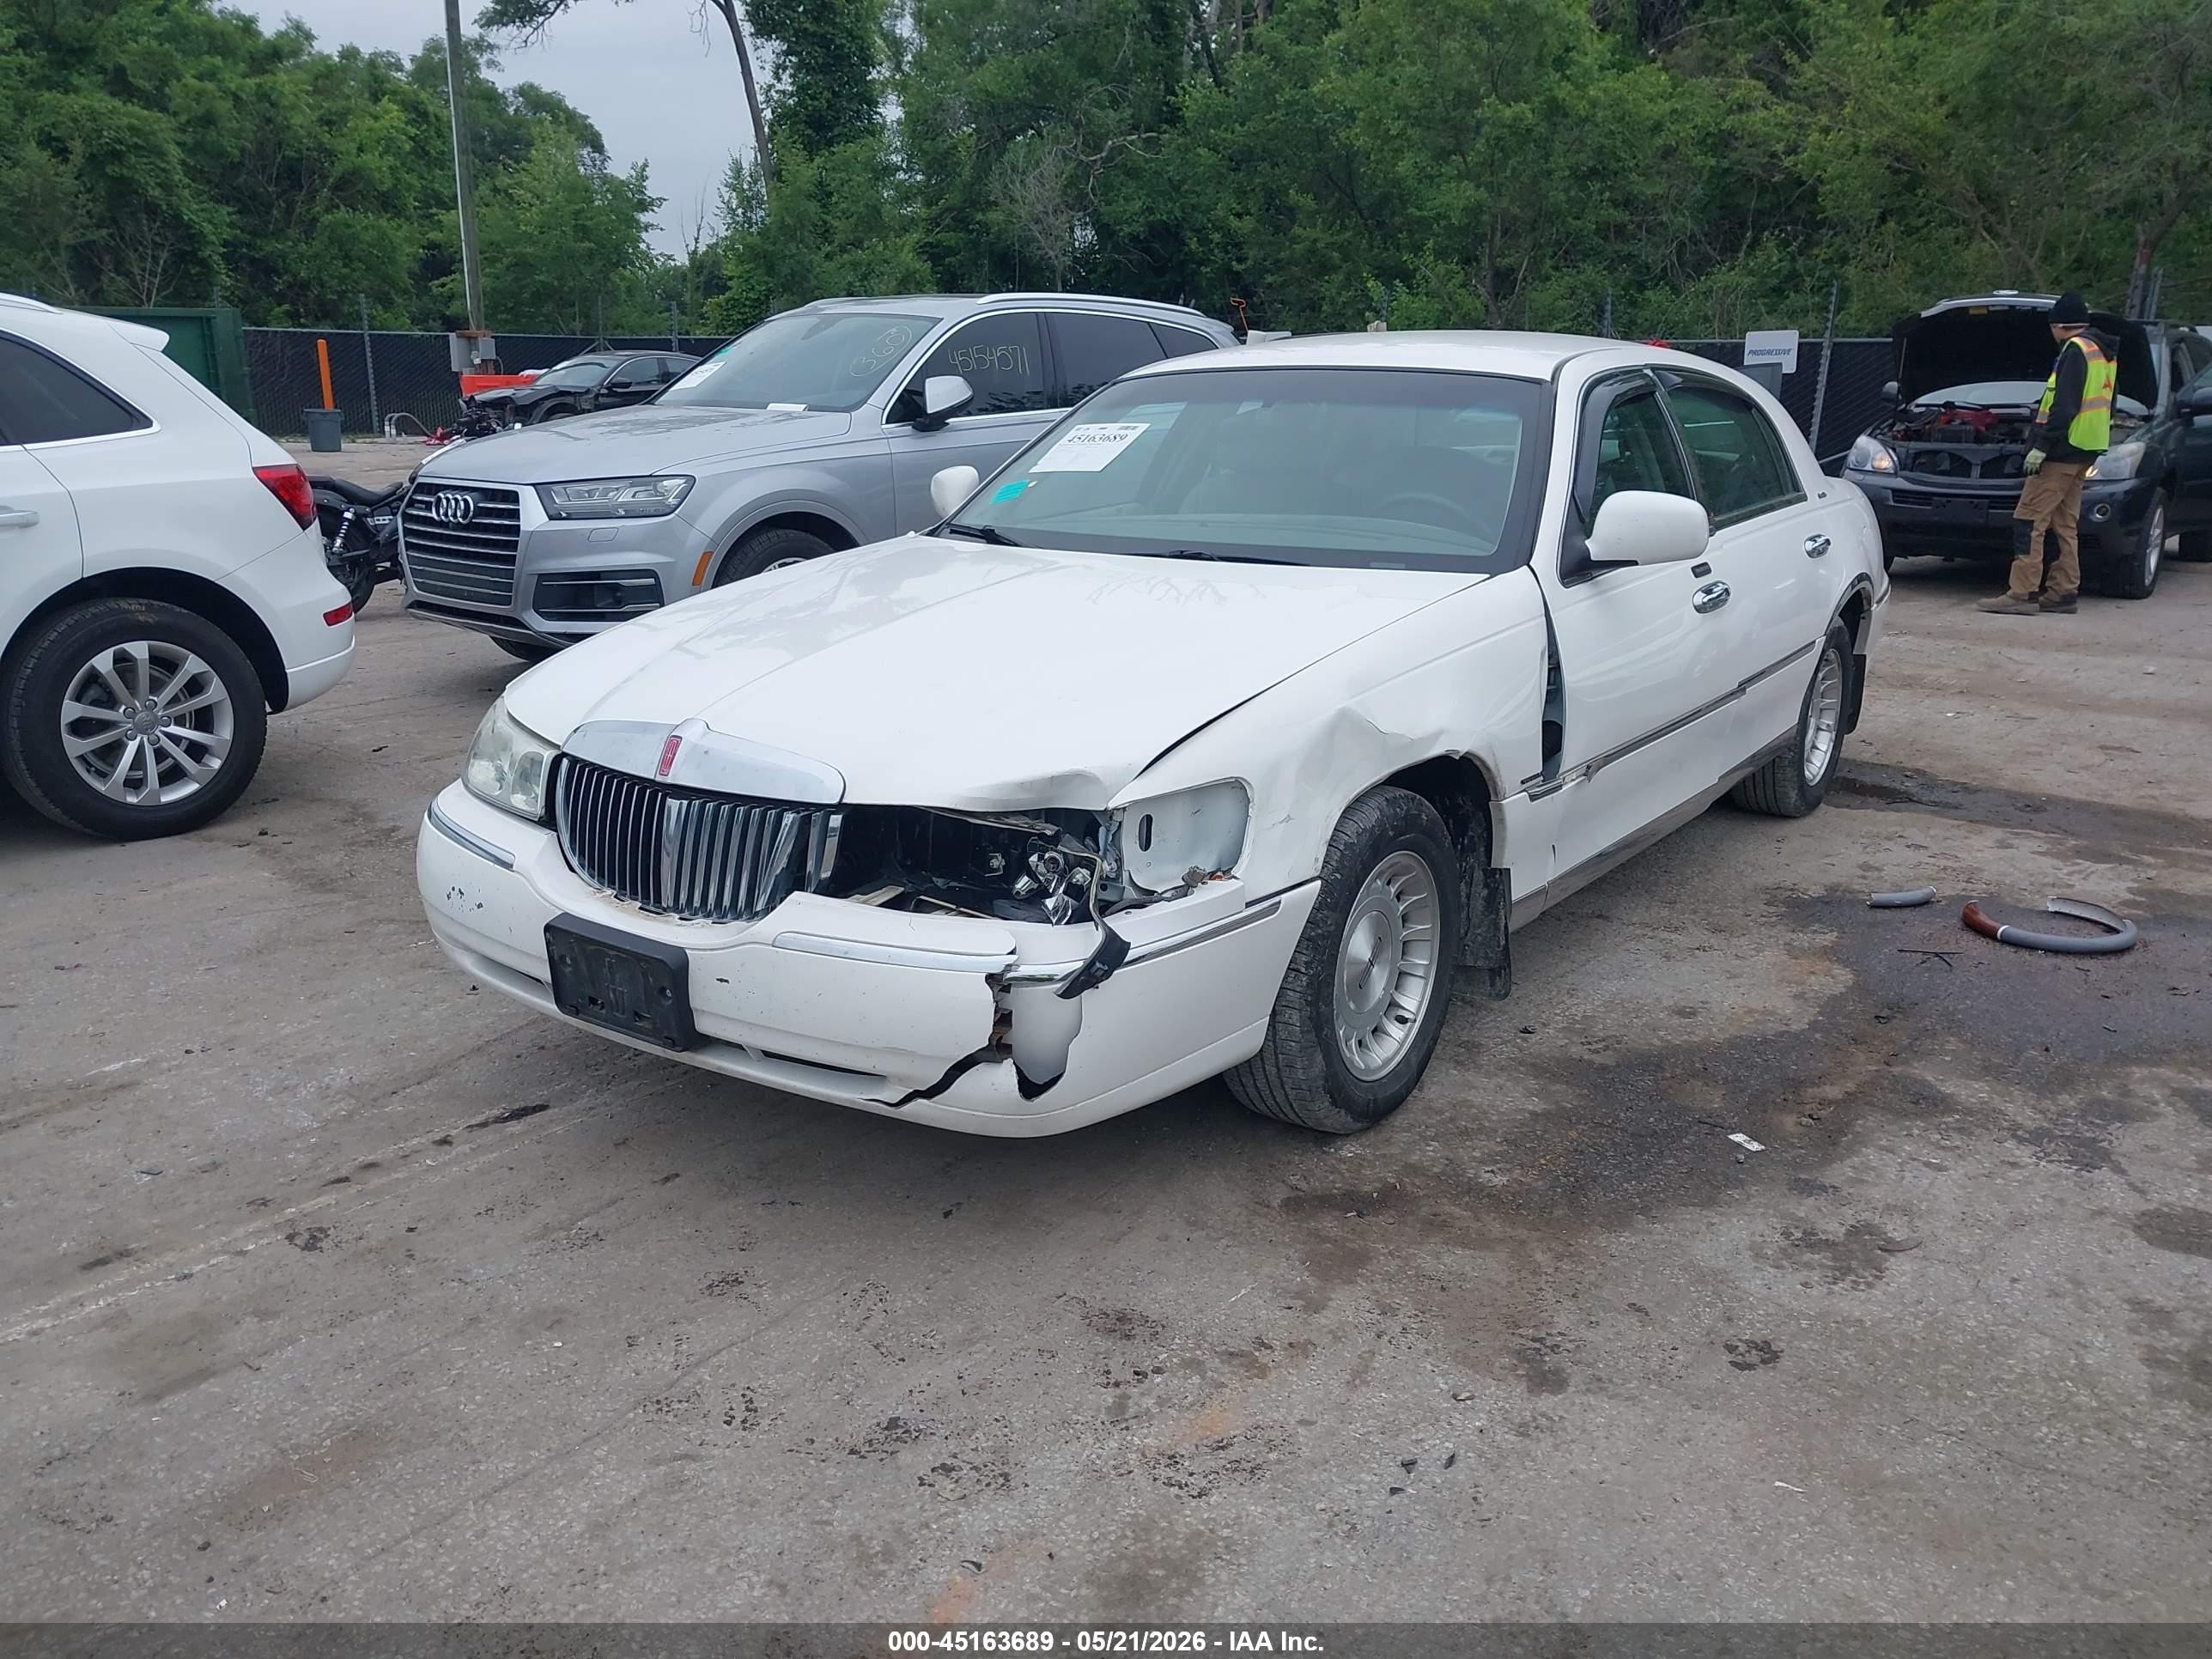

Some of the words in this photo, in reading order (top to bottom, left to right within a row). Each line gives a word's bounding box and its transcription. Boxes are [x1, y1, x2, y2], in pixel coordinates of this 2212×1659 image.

[1747, 348, 1793, 356] PROGRESSIVE
[948, 345, 1030, 374] 45154571
[1067, 433, 1128, 443] 45163689
